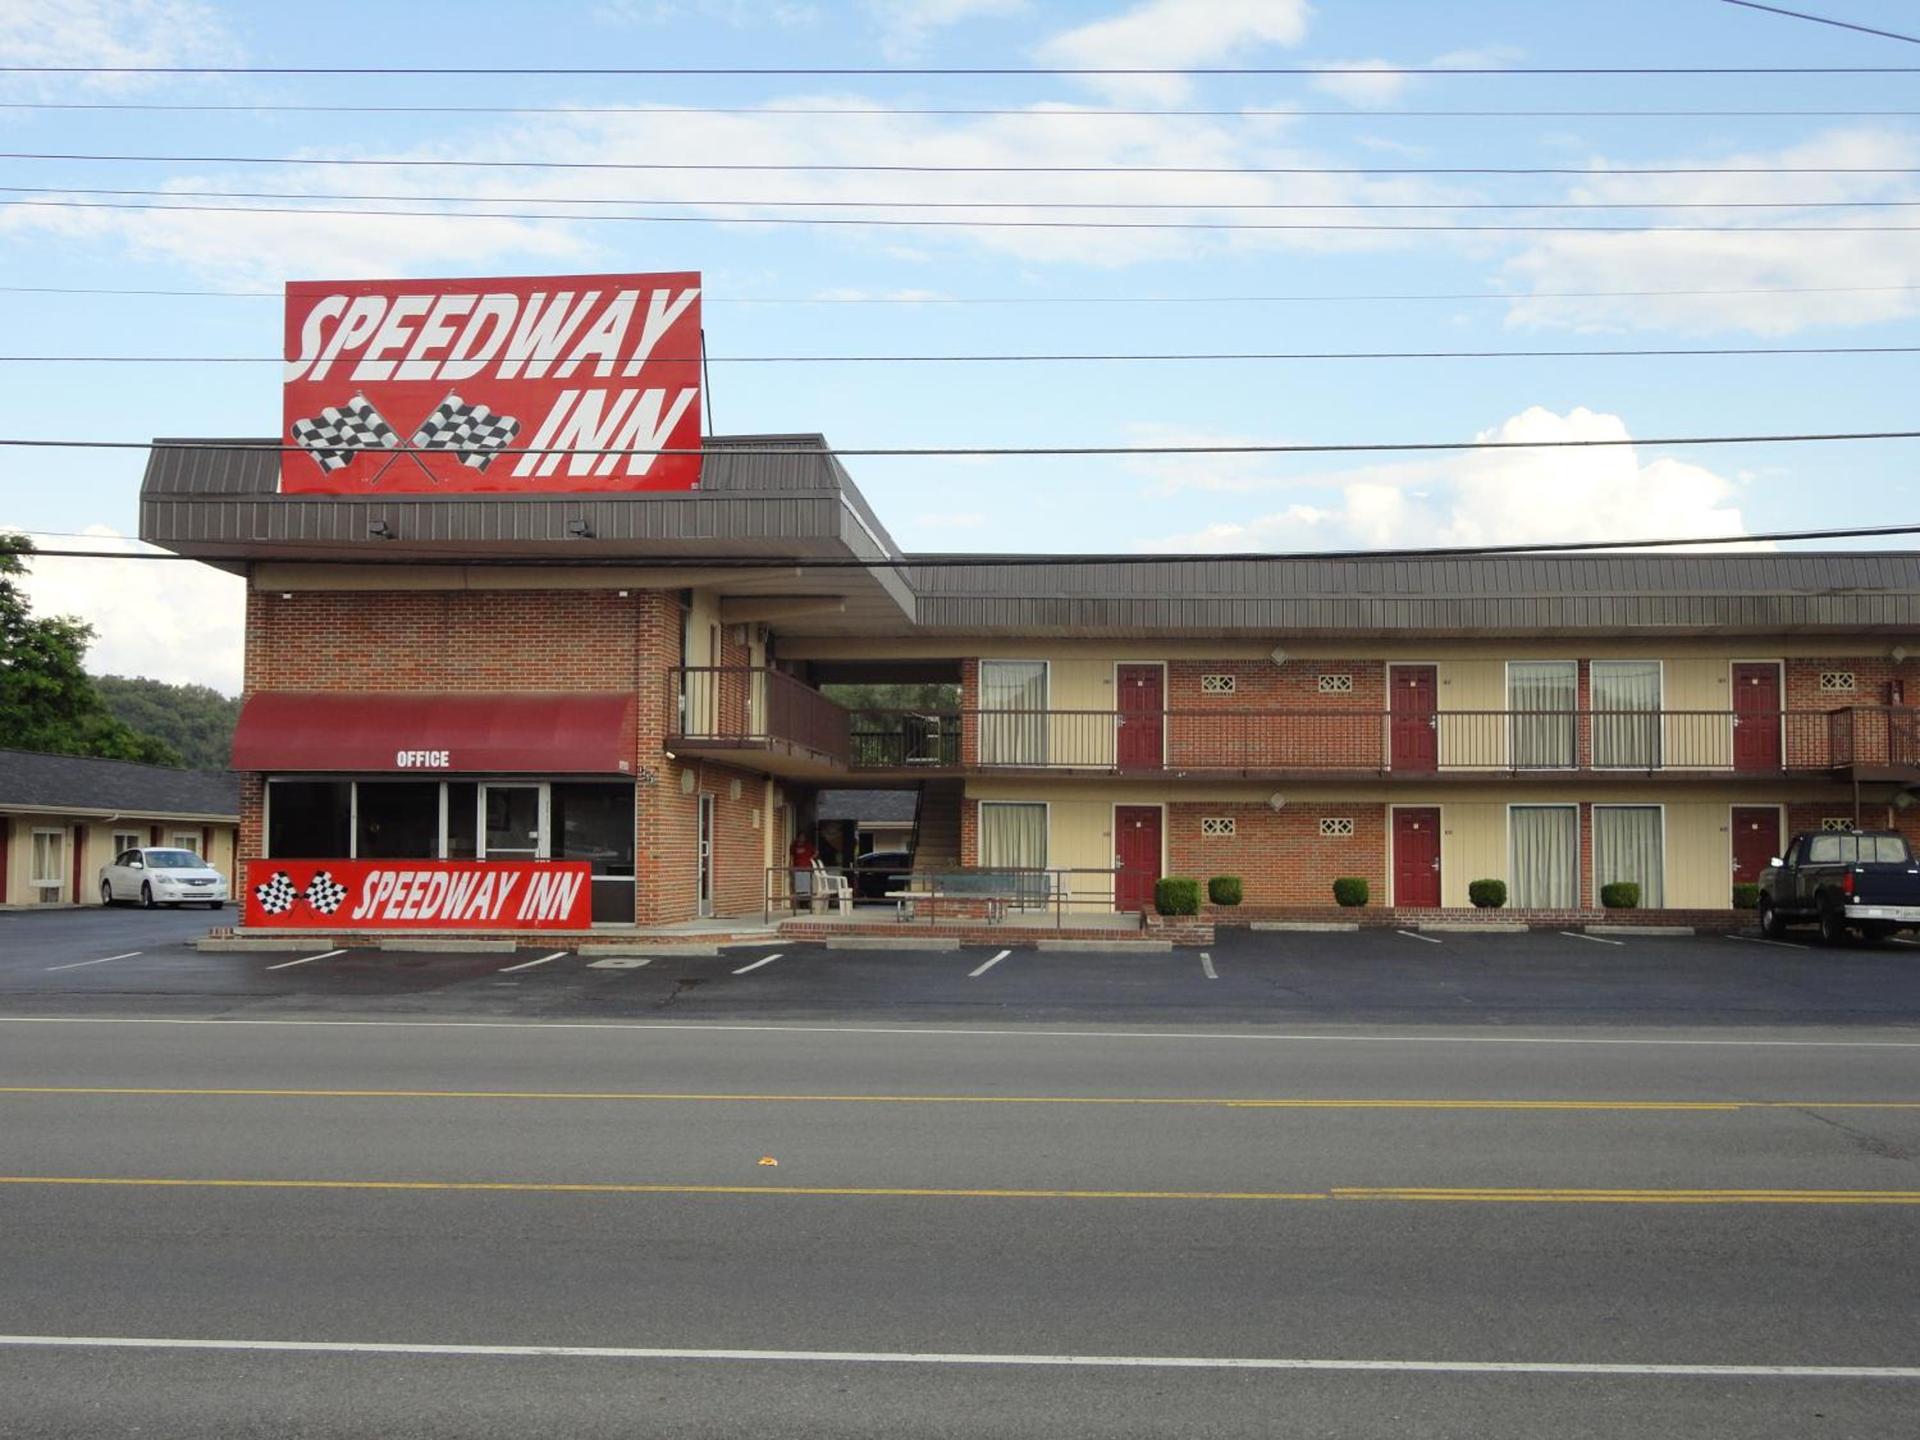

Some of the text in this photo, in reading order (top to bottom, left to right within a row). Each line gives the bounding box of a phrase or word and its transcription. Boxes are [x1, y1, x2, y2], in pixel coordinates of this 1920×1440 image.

[284, 288, 701, 383] SPEEDWAY
[511, 387, 699, 477] INN
[397, 751, 449, 767] OFFICE
[352, 870, 585, 921] SPEEDWAY INN
